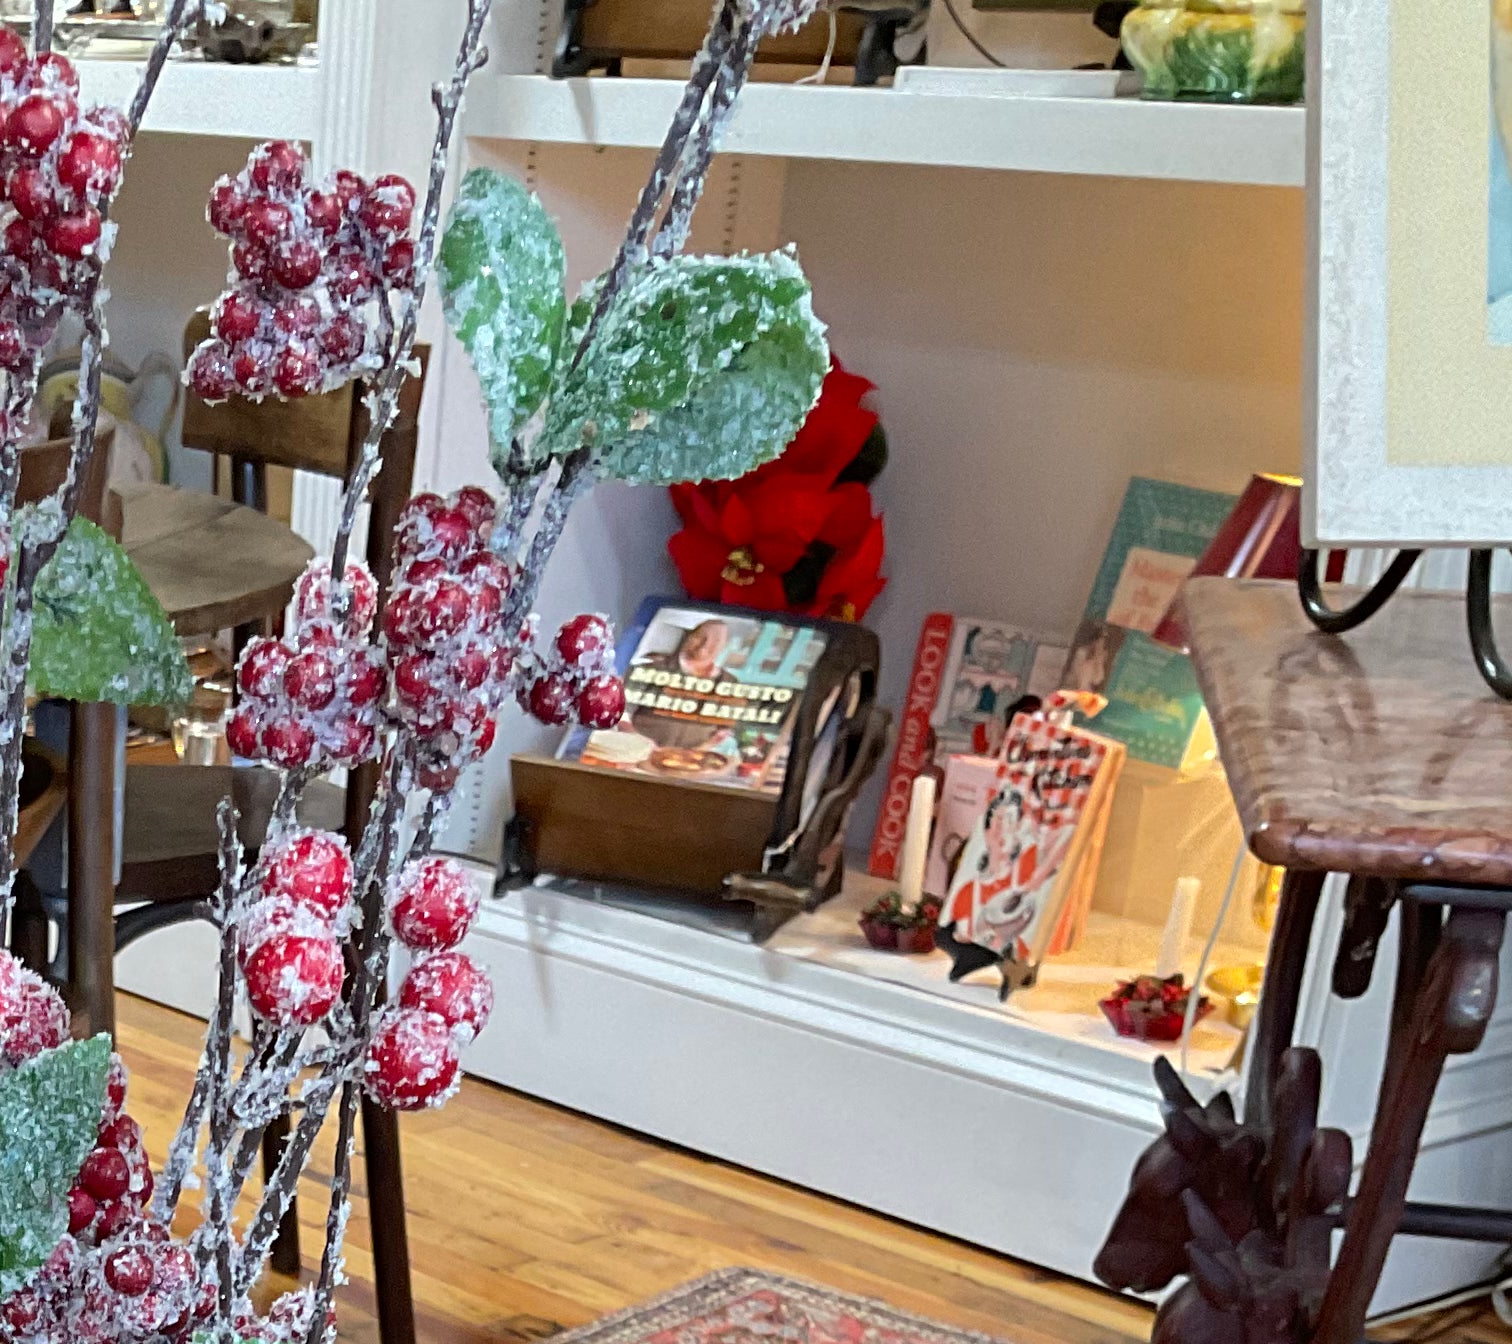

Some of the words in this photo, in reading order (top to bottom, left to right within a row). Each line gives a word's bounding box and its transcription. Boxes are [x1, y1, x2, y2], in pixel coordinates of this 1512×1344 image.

[629, 666, 715, 693] MOLTO
[715, 680, 793, 704] GUSTO
[911, 628, 948, 713] LOOK
[625, 688, 698, 714] MARIO
[700, 702, 783, 725] BATALI
[876, 773, 912, 858] COOK
